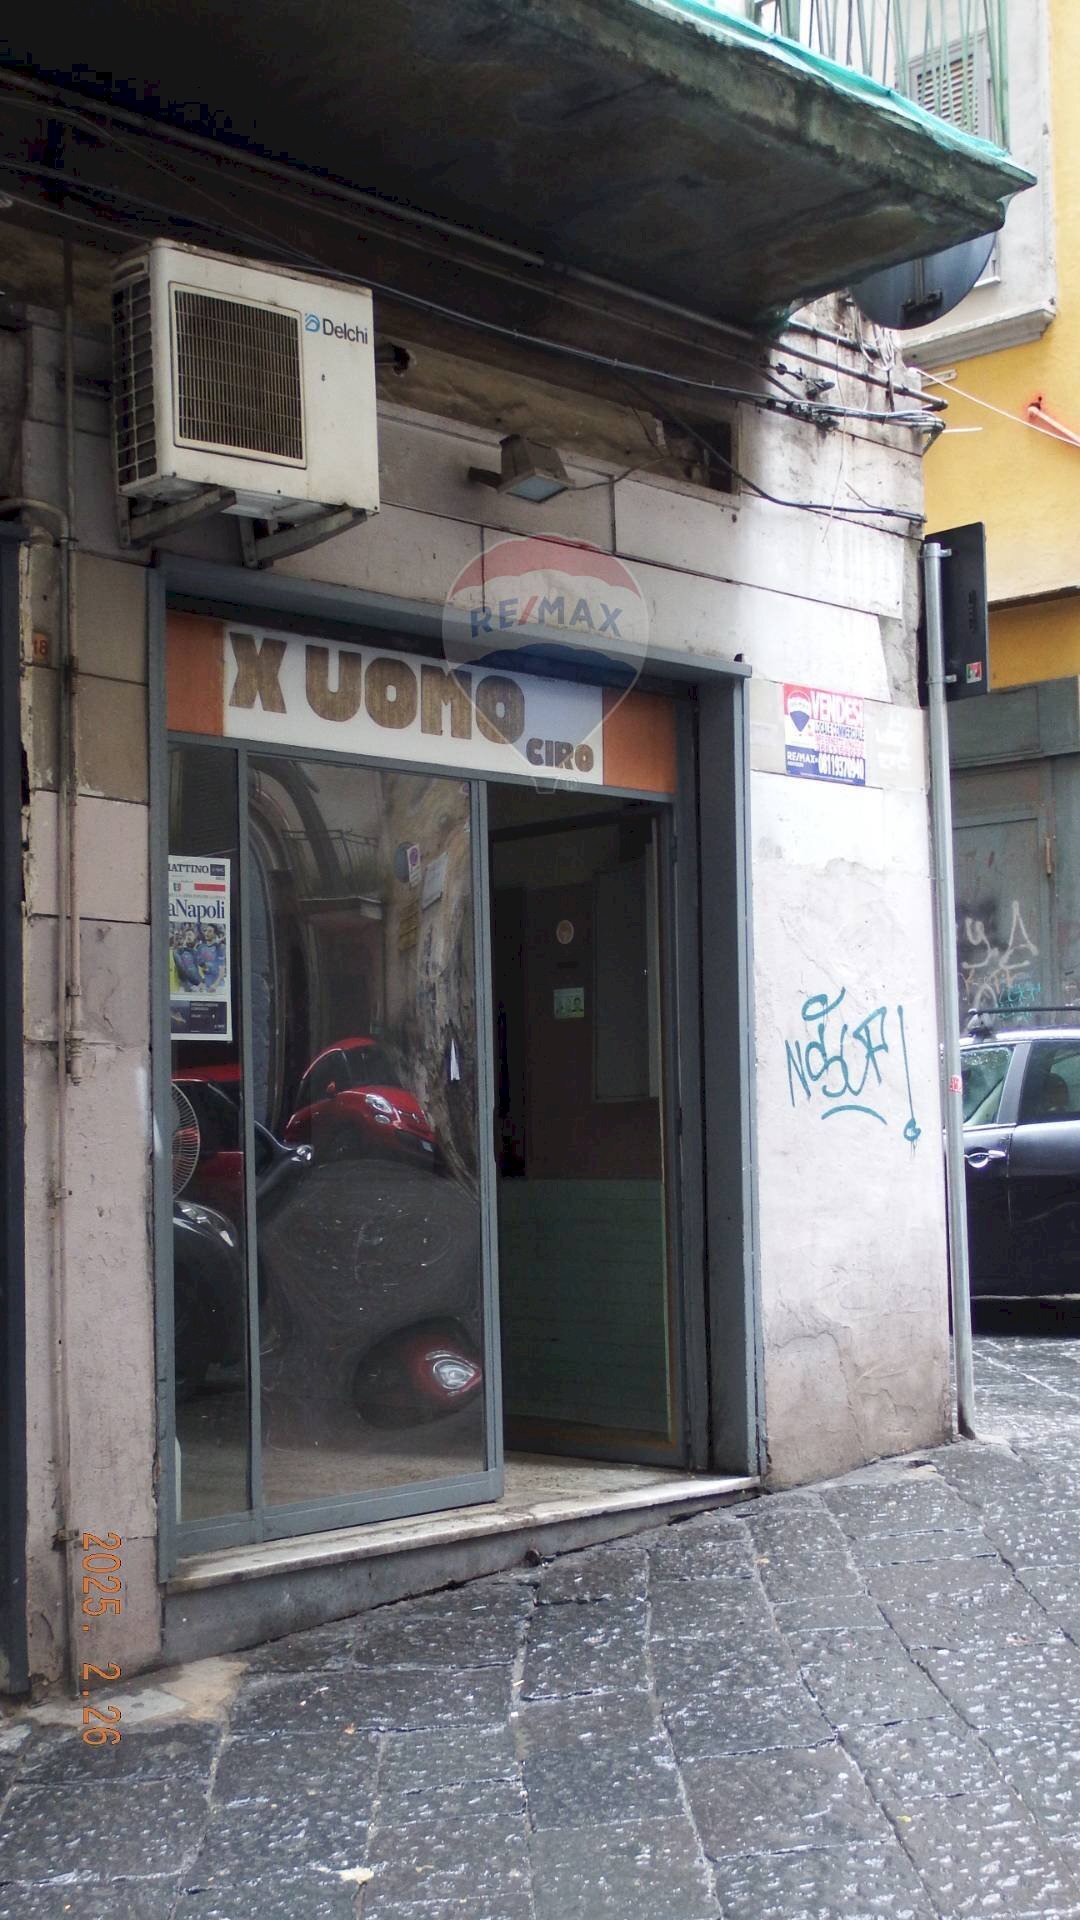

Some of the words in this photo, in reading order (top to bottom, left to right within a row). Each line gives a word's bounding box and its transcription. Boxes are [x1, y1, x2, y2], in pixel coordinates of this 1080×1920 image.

[322, 318, 368, 345] Delchi
[229, 631, 287, 714] X
[305, 644, 525, 745] UOMO
[525, 737, 594, 773] CIRO
